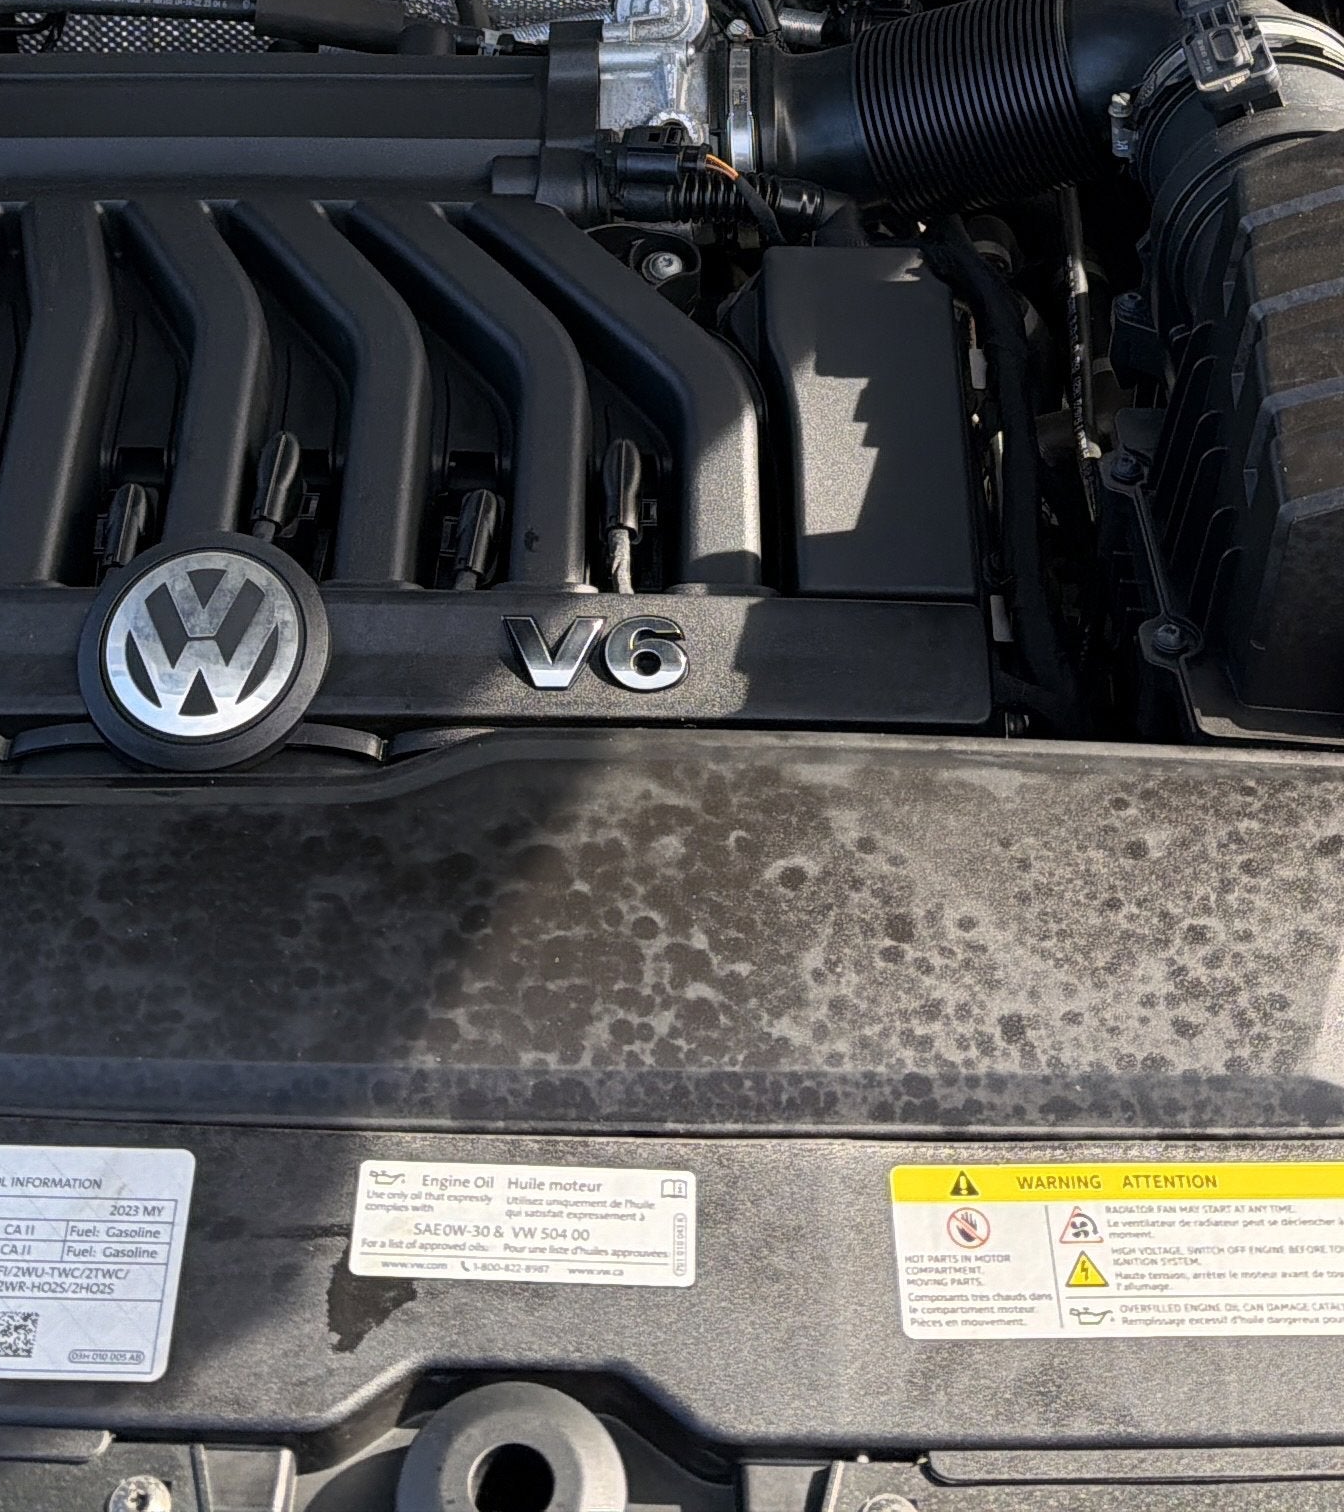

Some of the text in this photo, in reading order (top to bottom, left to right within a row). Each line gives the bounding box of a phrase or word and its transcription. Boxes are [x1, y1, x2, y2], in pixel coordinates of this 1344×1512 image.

[105, 551, 300, 738] VW
[501, 614, 691, 692] V6
[10, 1176, 102, 1189] INFORMATION
[422, 1174, 494, 1191] Engine Oil
[508, 1177, 603, 1193] Huile moteur
[1016, 1174, 1218, 1189] WARNING ATTENTION
[366, 1189, 492, 1205] Use only oil that expressly
[507, 1196, 544, 1206] Utilisez
[546, 1198, 607, 1208] uniquement
[609, 1199, 622, 1208] de
[109, 1204, 164, 1217] 2023 MY
[365, 1202, 434, 1213] complies with
[1179, 1205, 1200, 1213] MAY
[1202, 1205, 1232, 1213] START
[1234, 1205, 1245, 1213] AT
[1248, 1205, 1267, 1213] ANY
[505, 1208, 522, 1219] qui
[524, 1208, 564, 1218] satisfait
[1179, 1219, 1192, 1227] de
[1194, 1219, 1239, 1227] radiateur
[4, 1224, 22, 1235] CA
[69, 1226, 161, 1239] Fuel: Gasoline
[493, 1225, 504, 1238] &
[512, 1227, 537, 1239] VW
[541, 1228, 567, 1240] 504
[571, 1229, 590, 1241] 00
[0, 1244, 18, 1255] CA
[361, 1238, 466, 1252] For a list of approved
[504, 1243, 527, 1253] Pour
[528, 1245, 547, 1254] une
[549, 1245, 569, 1254] liste
[1111, 1247, 1135, 1255] HIGH
[1187, 1247, 1224, 1255] SWITCH
[1227, 1246, 1246, 1254] OFF
[1249, 1245, 1286, 1254] ENGINE
[1288, 1245, 1328, 1254] BEFORE
[66, 1245, 158, 1259] Fuel: Gasoline
[905, 1254, 1011, 1263] HOT PARTS IN MOTOR
[1113, 1258, 1158, 1266] IGNITION
[381, 1261, 447, 1269] www.vw.com
[1229, 1271, 1238, 1279] le
[1241, 1271, 1277, 1279] moteur
[1312, 1270, 1324, 1278] de
[907, 1278, 948, 1286] MOVING
[908, 1292, 969, 1303] Composants
[992, 1293, 1027, 1301] chauds
[1029, 1293, 1053, 1301] dans
[921, 1306, 995, 1315] compartiment
[1119, 1304, 1181, 1313] OVERFILLED
[1184, 1303, 1220, 1312] ENGINE
[1243, 1303, 1264, 1312] CAN
[1267, 1303, 1310, 1311] DAMAGE
